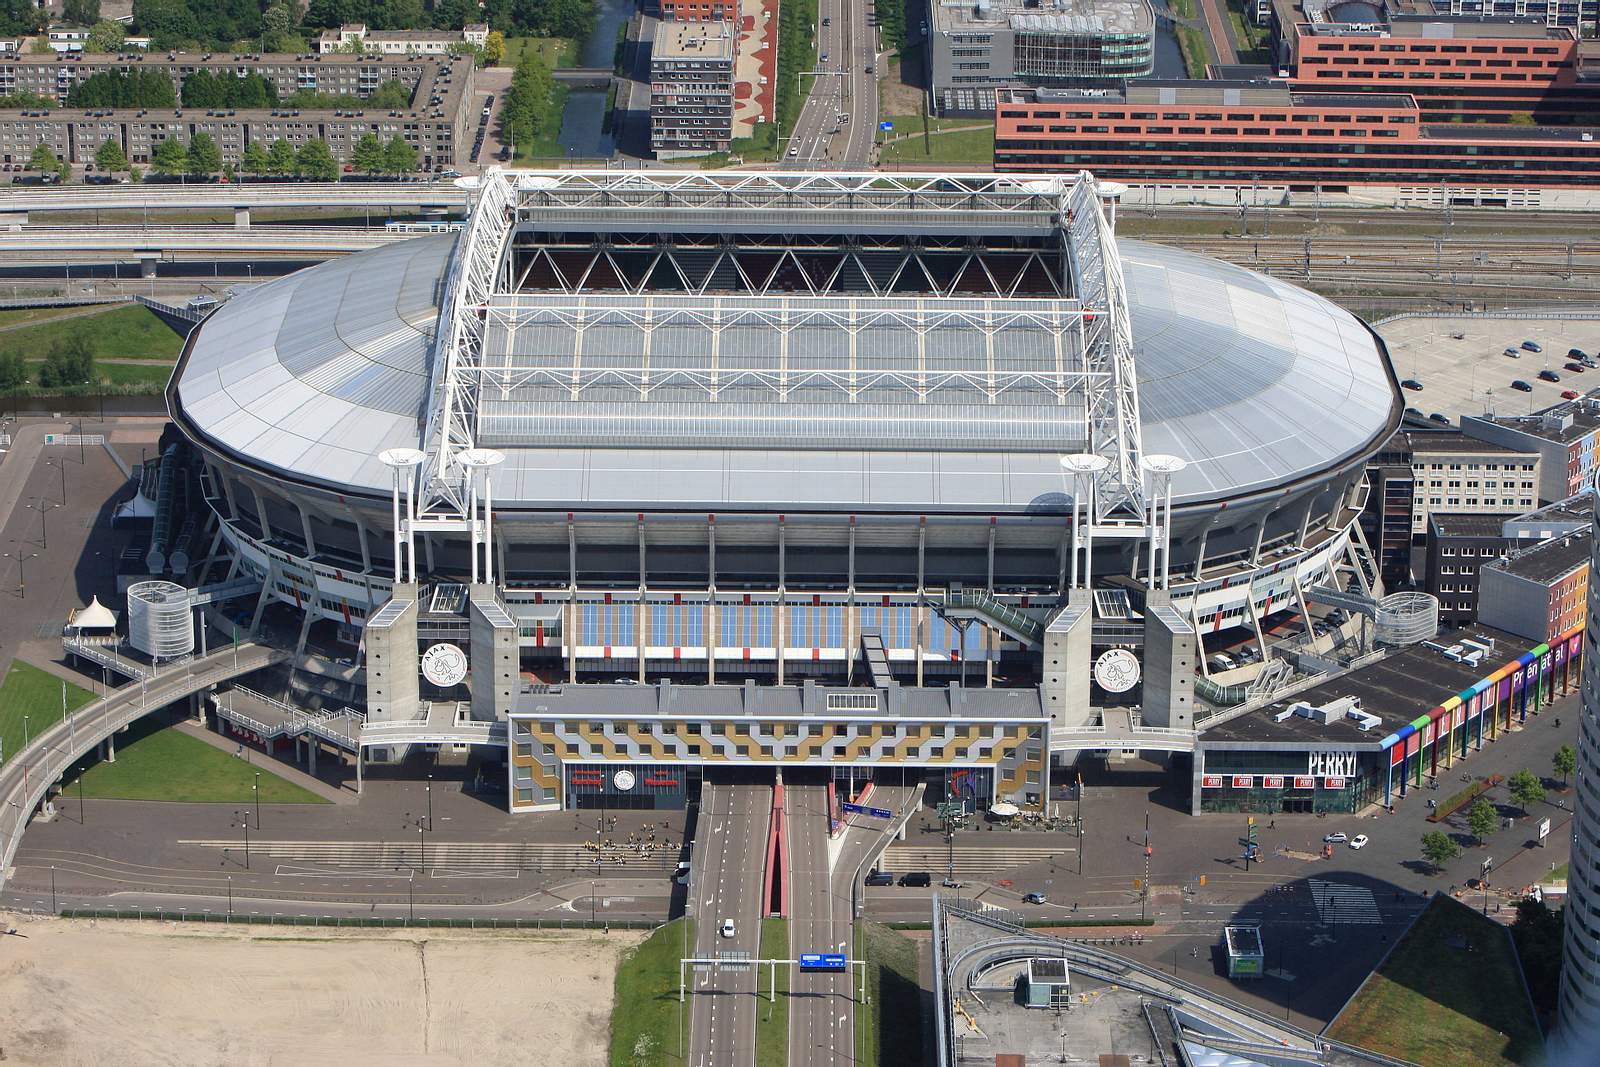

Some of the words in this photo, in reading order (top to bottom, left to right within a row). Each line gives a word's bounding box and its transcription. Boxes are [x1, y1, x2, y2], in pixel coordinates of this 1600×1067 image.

[425, 645, 445, 661] AJAX
[1098, 651, 1118, 667] AJAX
[1308, 751, 1354, 777] PERRY
